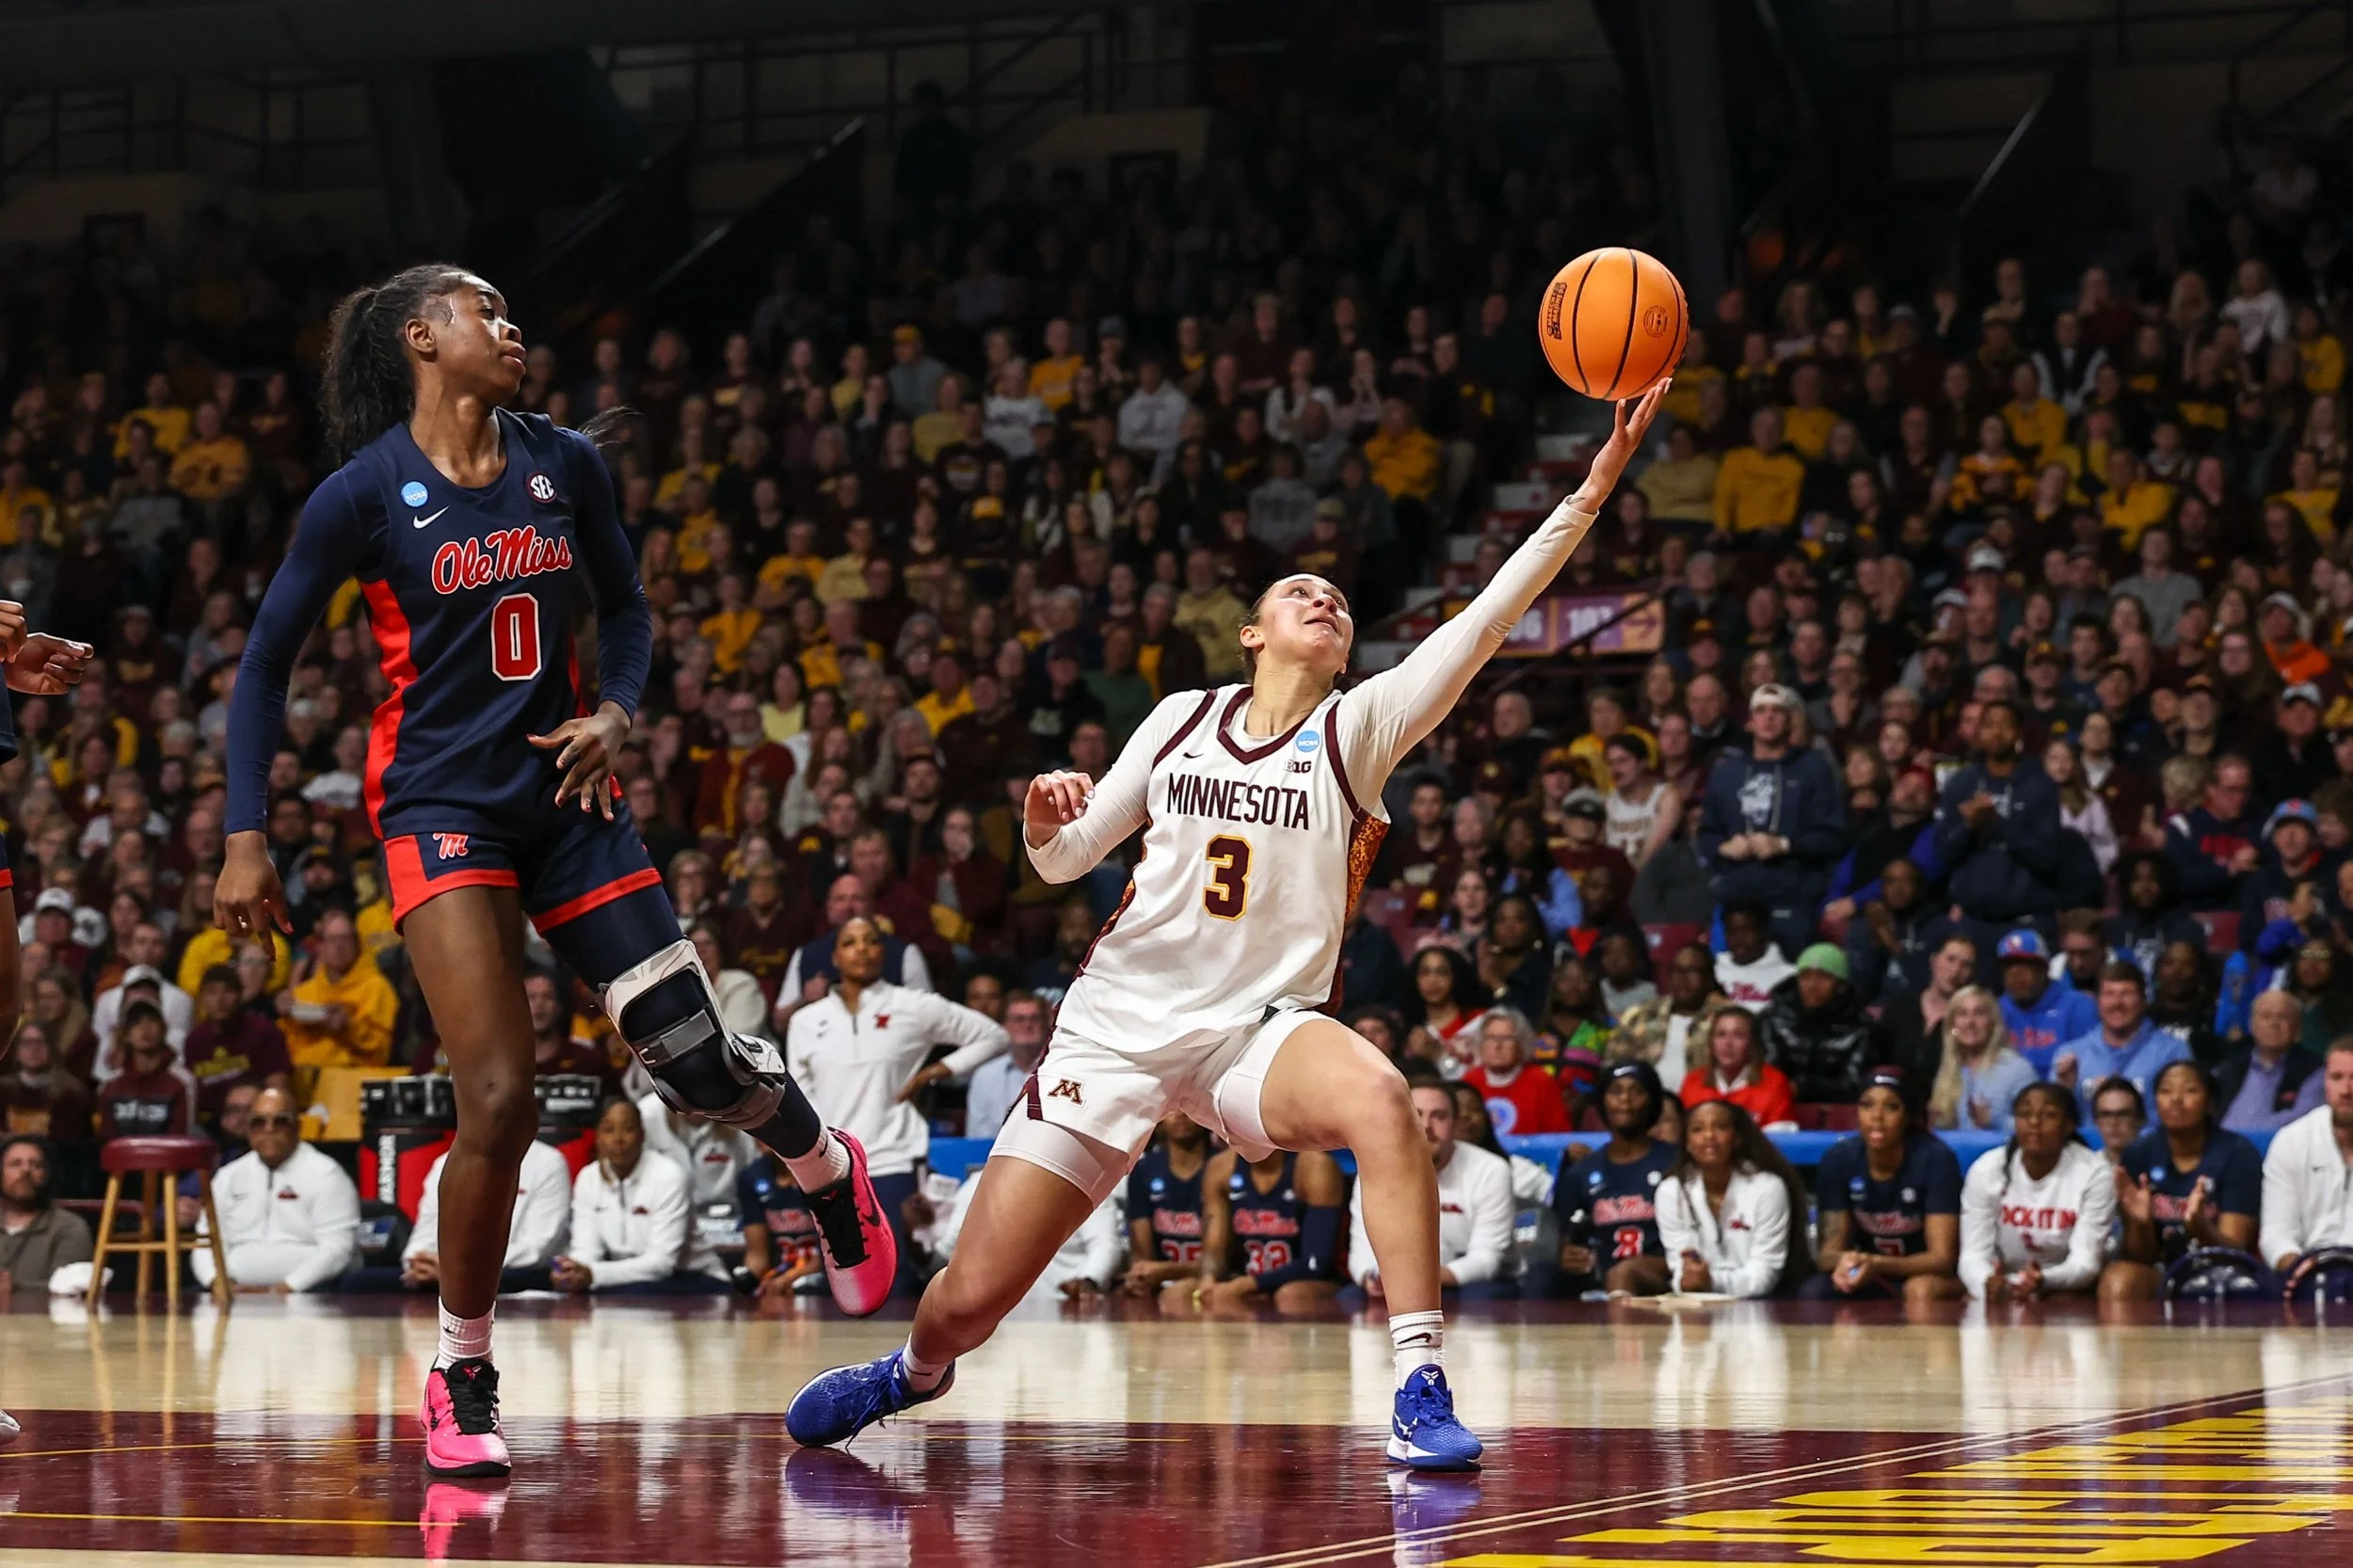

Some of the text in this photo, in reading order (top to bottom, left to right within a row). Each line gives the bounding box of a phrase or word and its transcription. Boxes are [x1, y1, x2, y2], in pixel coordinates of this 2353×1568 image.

[530, 474, 555, 500] SEC
[432, 525, 572, 594] Ole Miss
[491, 592, 541, 681] 0
[1298, 739, 1320, 747] NCAA
[1167, 773, 1309, 831] MINNESOTA
[1202, 834, 1254, 921] 3
[1048, 1078, 1083, 1106] M
